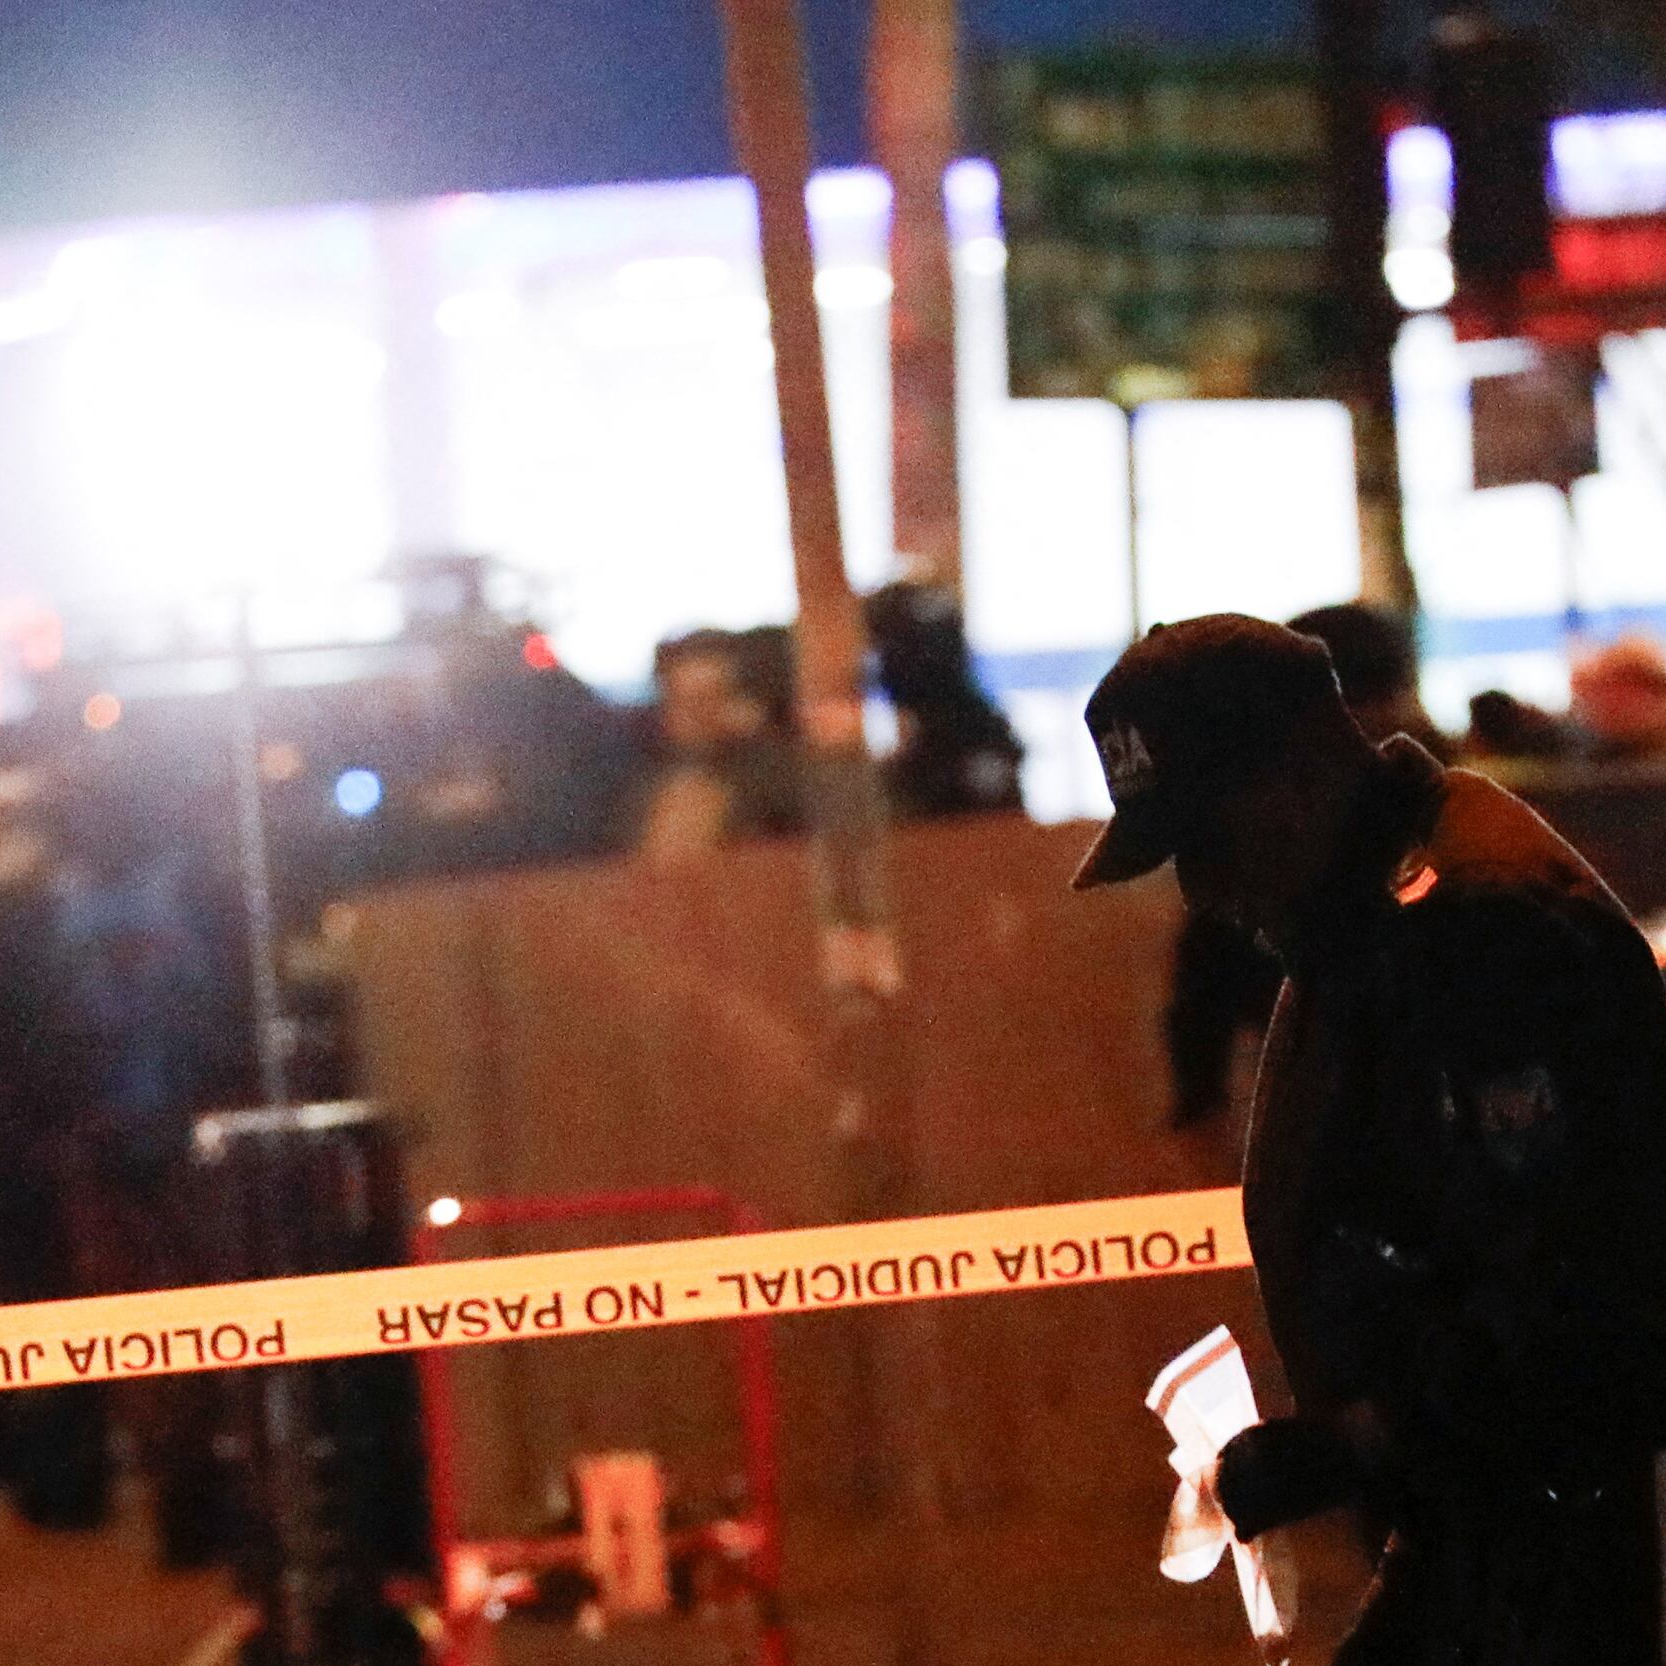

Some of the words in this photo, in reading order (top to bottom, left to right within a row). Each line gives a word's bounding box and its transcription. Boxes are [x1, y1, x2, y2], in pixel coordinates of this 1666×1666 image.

[718, 1252, 974, 1309] JUDICIAL
[993, 1228, 1216, 1283] POLICIA
[378, 1293, 562, 1343] PASAR
[586, 1283, 663, 1324] NO
[64, 1321, 285, 1374] POLICIA
